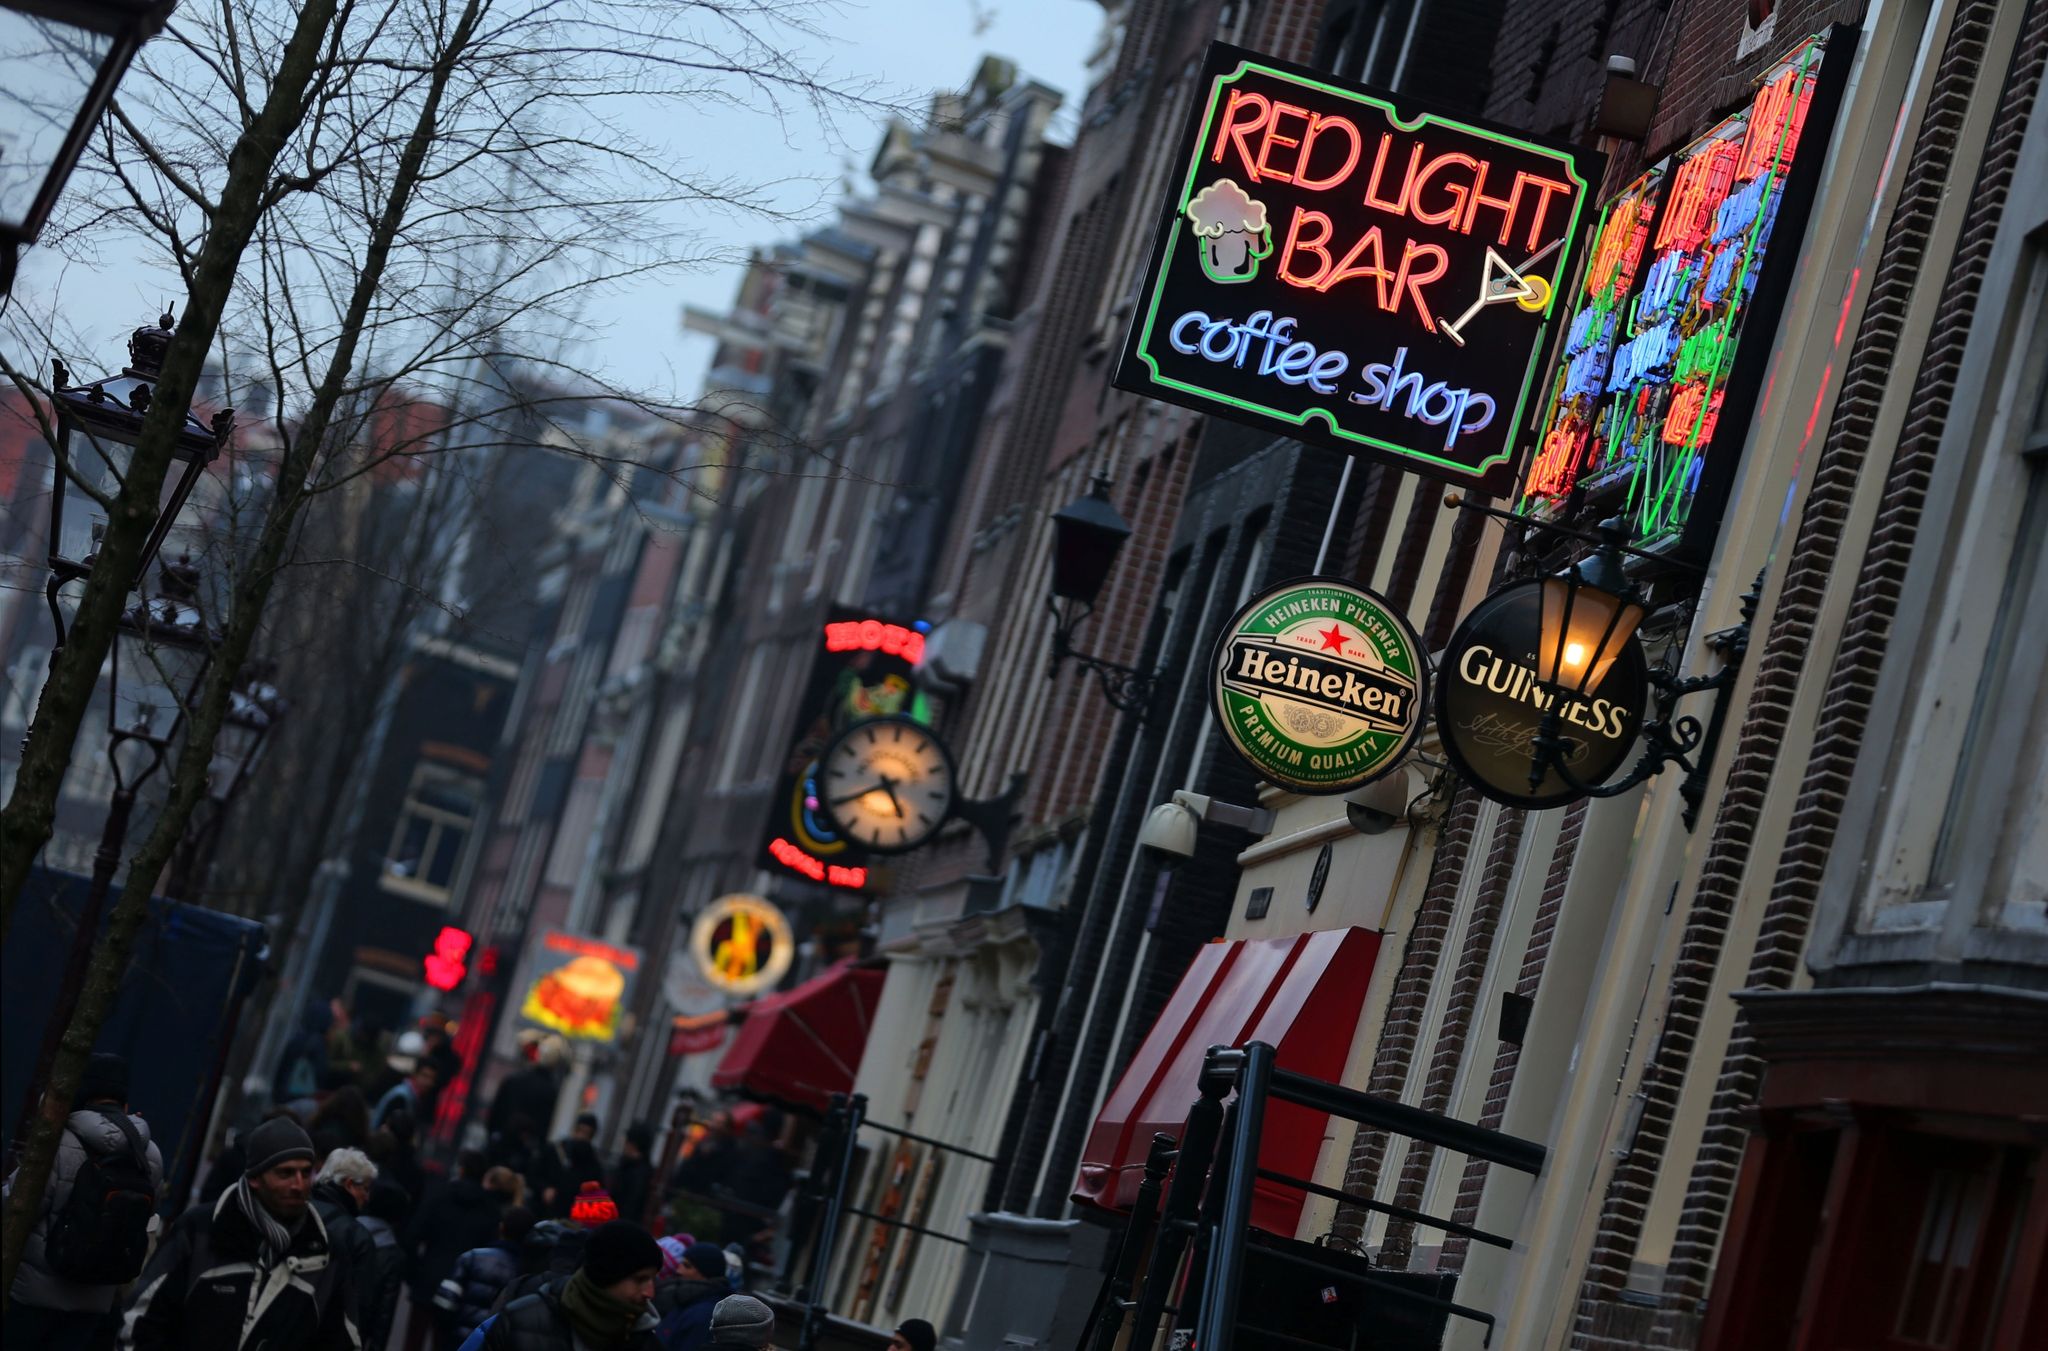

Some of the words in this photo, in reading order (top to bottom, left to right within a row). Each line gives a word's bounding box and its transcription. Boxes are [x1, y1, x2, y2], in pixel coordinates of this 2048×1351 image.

[1210, 88, 1363, 191] RED
[1364, 131, 1571, 253] LIGHT
[1276, 205, 1450, 335] BAR
[1169, 309, 1349, 395] coffee
[1349, 346, 1497, 451] shop
[1264, 597, 1341, 629] HEINEKEN
[1344, 603, 1400, 660] PILSENER
[1296, 636, 1317, 645] TRADE
[1347, 648, 1366, 659] MARK
[1237, 648, 1401, 718] Heineken
[1239, 704, 1303, 767] PREMIUM
[1309, 736, 1379, 770] QUALITY
